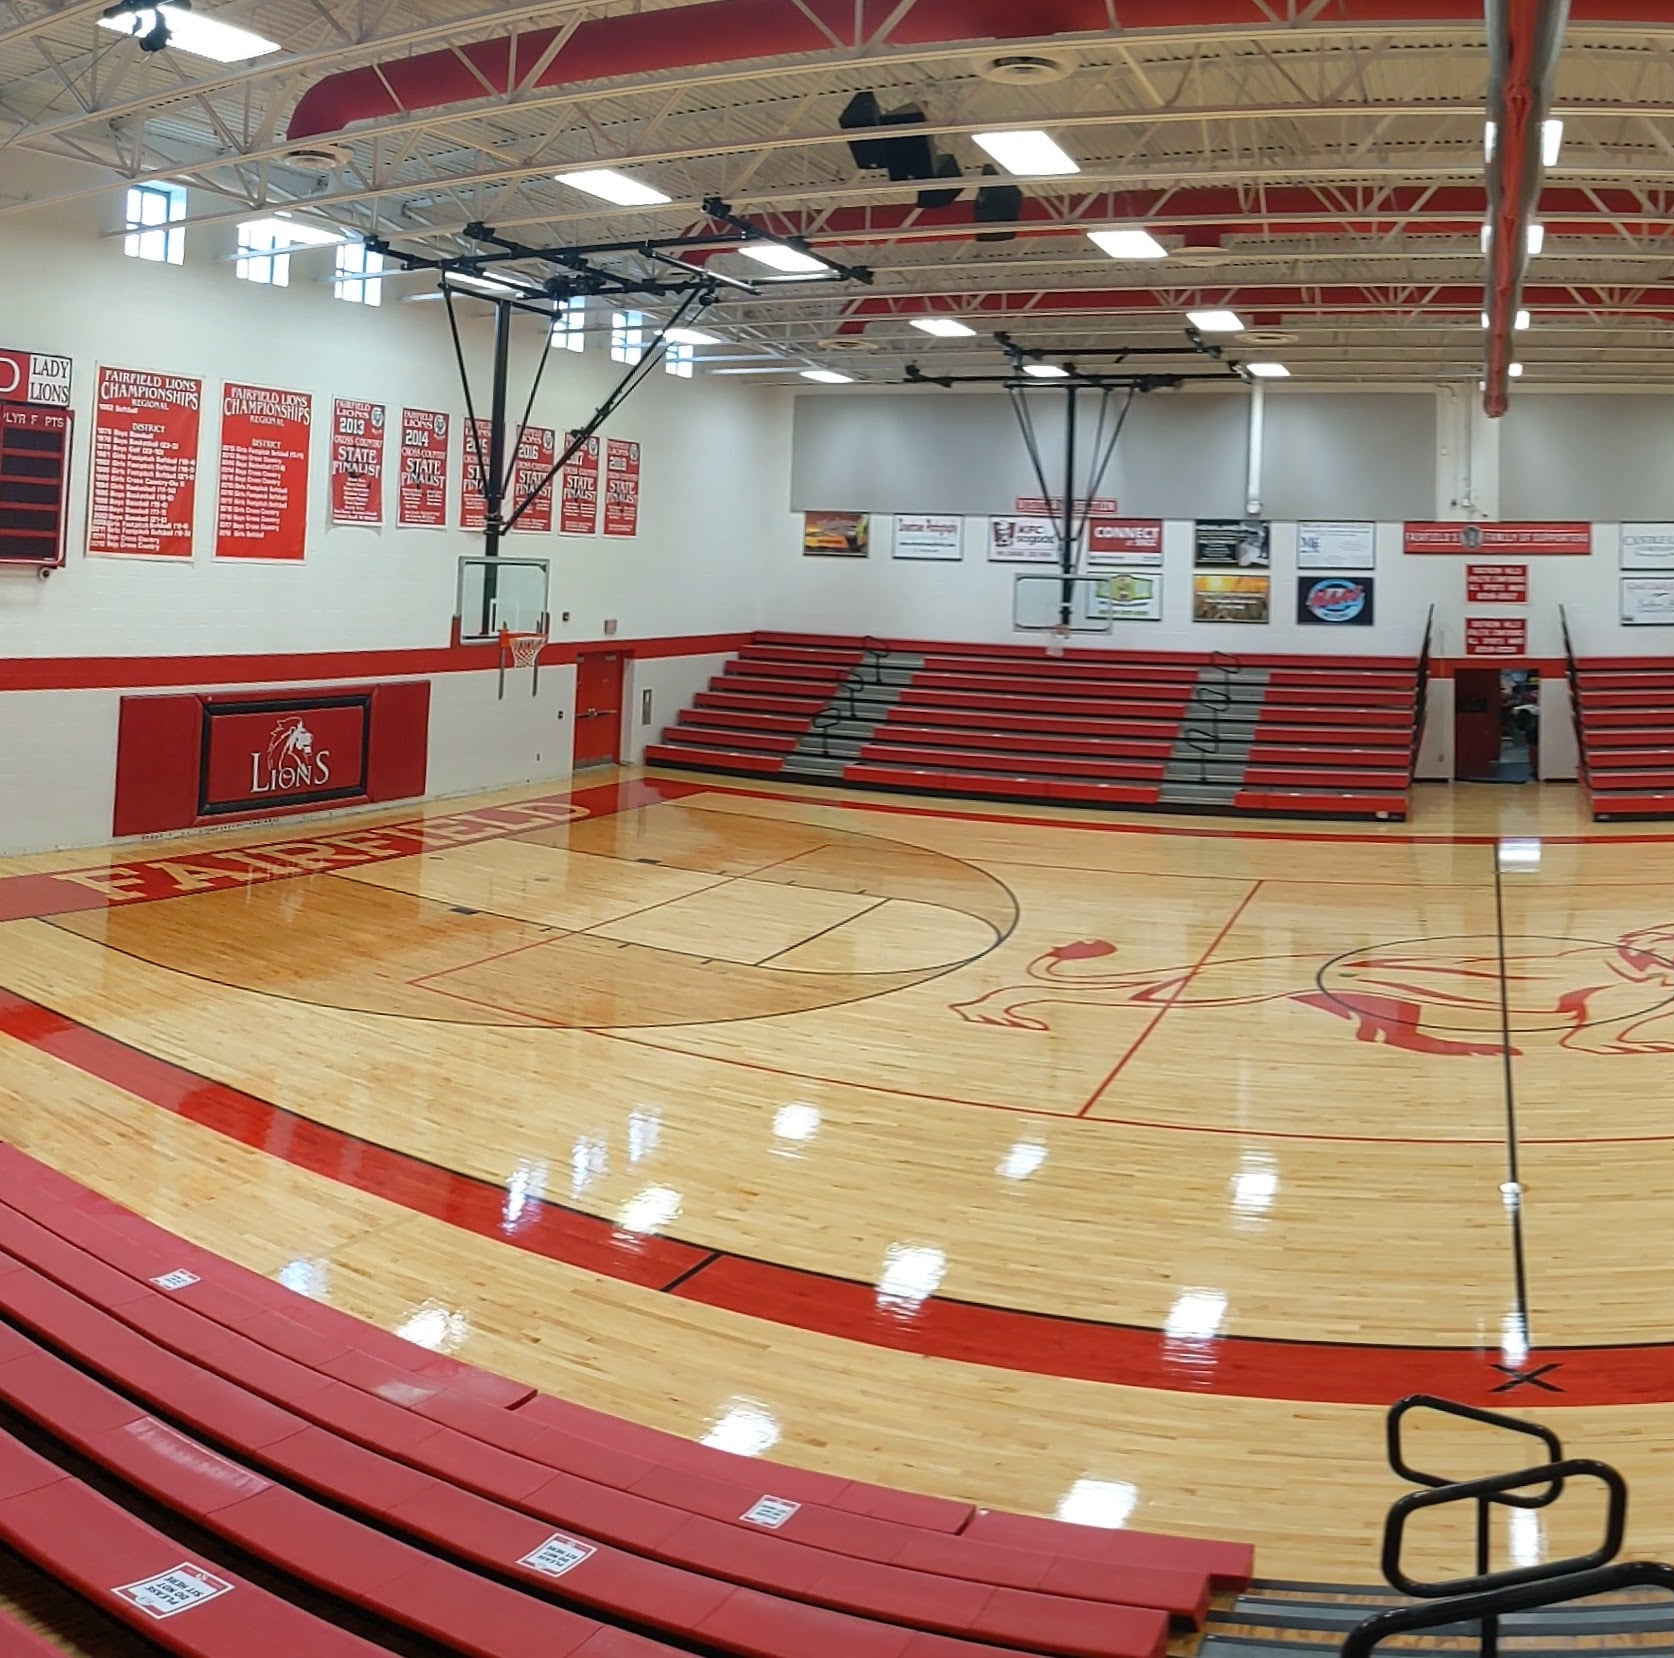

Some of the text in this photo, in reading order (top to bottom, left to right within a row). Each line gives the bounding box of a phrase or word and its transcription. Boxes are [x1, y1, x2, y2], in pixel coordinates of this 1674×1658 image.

[32, 357, 69, 378] LADY
[105, 370, 197, 392] FAIRFIELD LIONS
[30, 382, 69, 403] LIONS
[101, 381, 199, 410] CHAMPIONSHIPS
[231, 387, 308, 407] FAIRFIELD LIONS
[131, 398, 170, 411] REGIONAL
[224, 397, 310, 425] CHAMPIONSHIPS
[336, 407, 370, 419] LIONS
[3, 412, 64, 428] LYR F PTS
[132, 422, 166, 433] DISTRICT
[339, 417, 365, 435] 2013
[404, 418, 433, 430] LIONS
[405, 429, 429, 447] 2014
[338, 445, 377, 464] STATE
[332, 460, 380, 478] FINALIST
[406, 457, 441, 475] STATE
[401, 472, 446, 489] FINALIST
[1017, 525, 1044, 535] KFC
[1094, 526, 1160, 539] CONNECT
[250, 750, 330, 793] LIONS
[53, 802, 592, 901] FAIRFIELD
[164, 1576, 187, 1589] HERE
[145, 1586, 179, 1605] PLEASE
